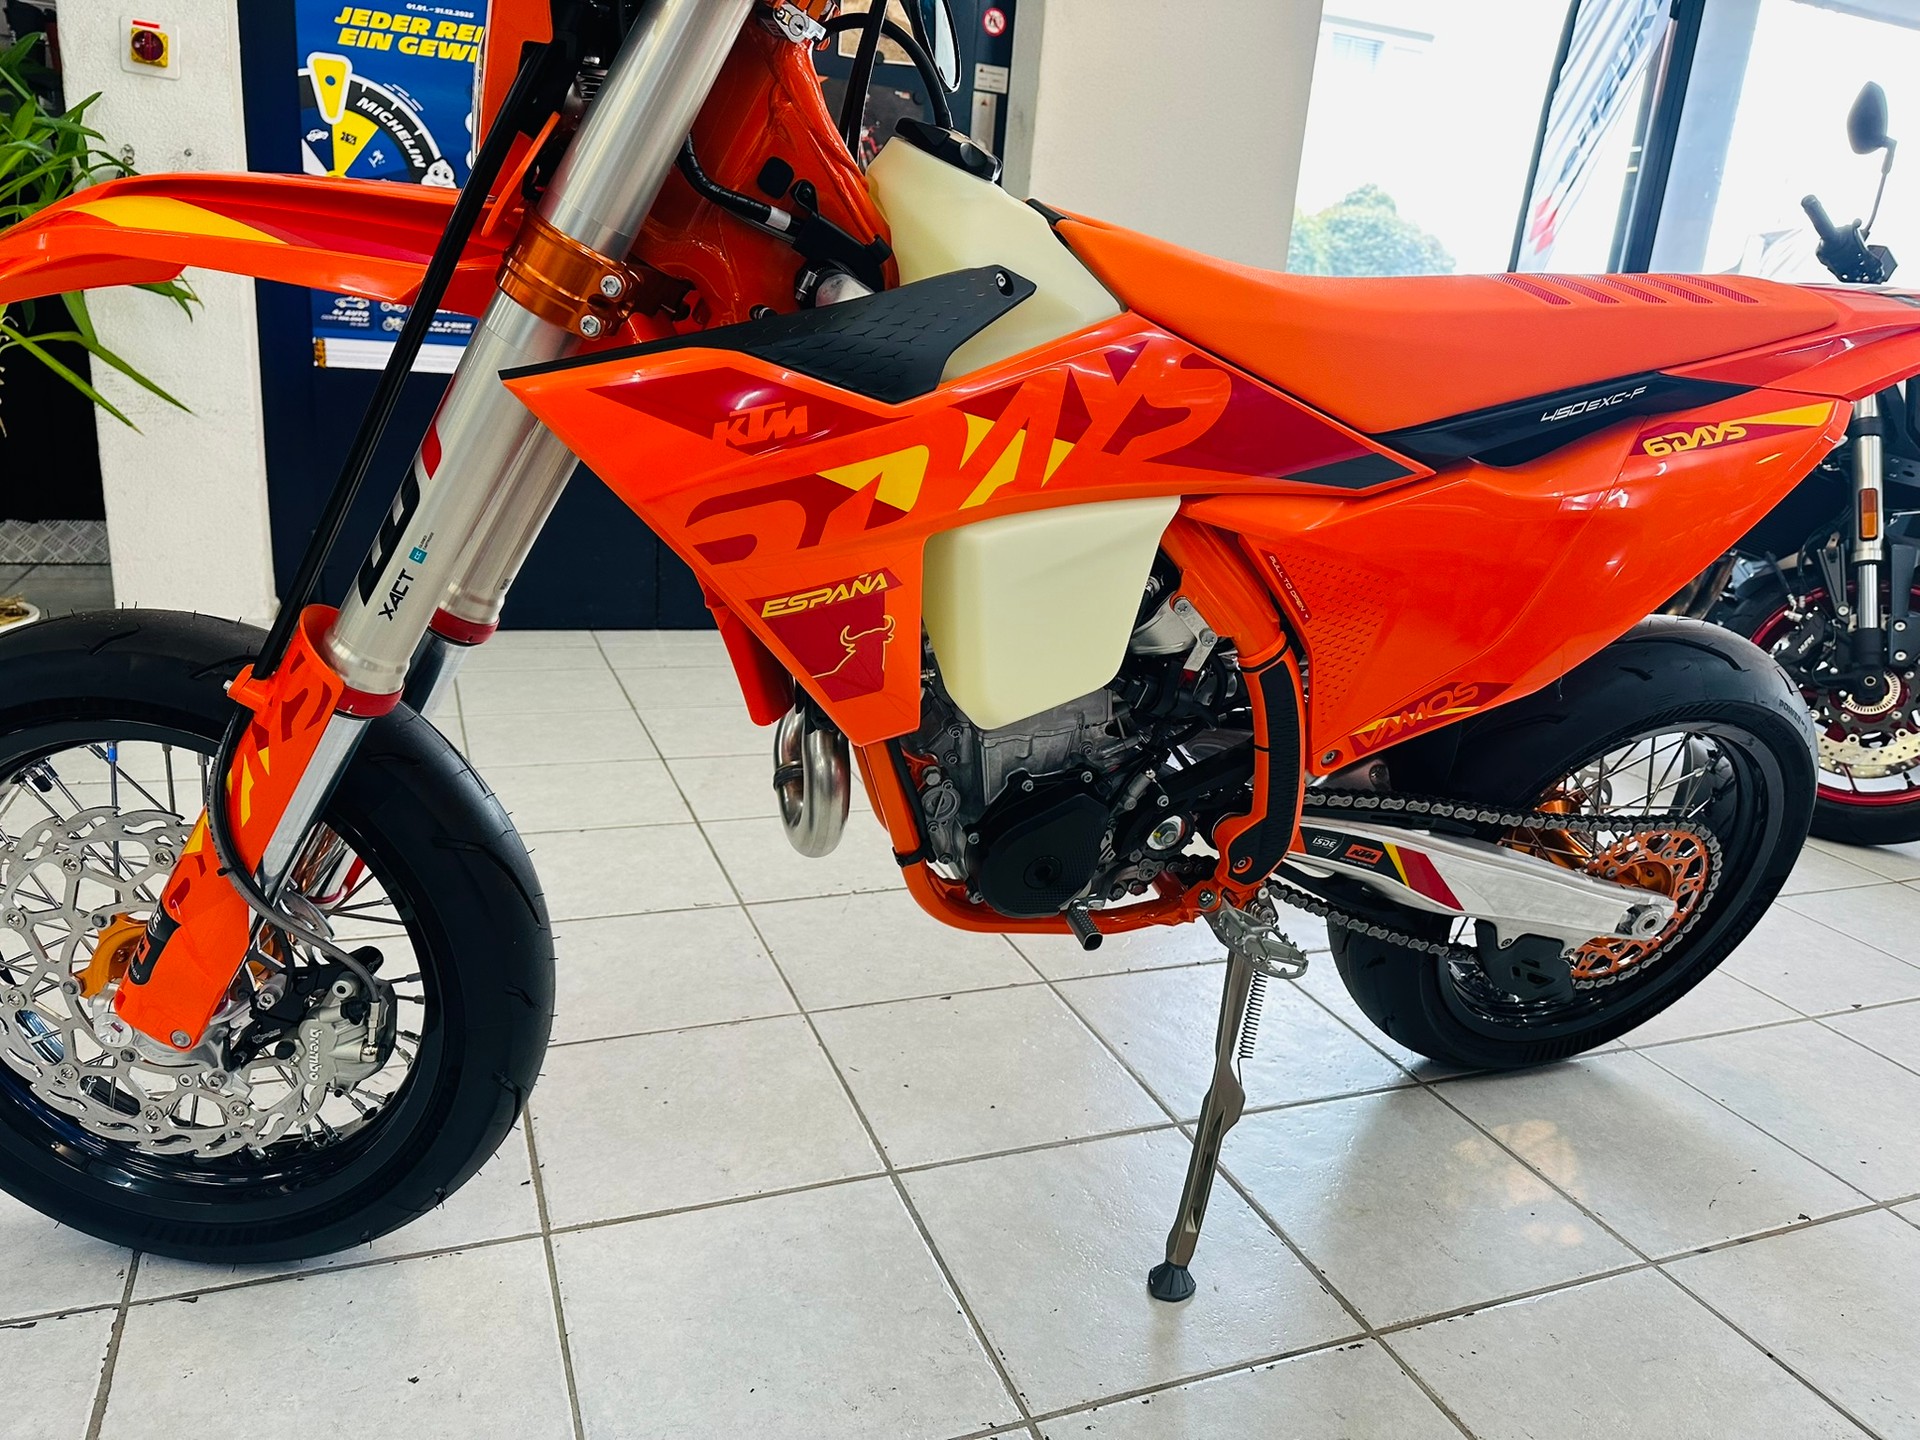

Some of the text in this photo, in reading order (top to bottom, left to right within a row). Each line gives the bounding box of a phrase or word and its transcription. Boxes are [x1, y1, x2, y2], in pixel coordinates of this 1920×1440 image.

[334, 6, 431, 36] JEDER
[337, 28, 394, 51] EIN
[356, 96, 427, 169] MICHELIN
[712, 401, 809, 448] KTM
[1642, 421, 1747, 457] 6DAYS
[378, 568, 414, 621] XACT
[761, 572, 888, 618] ESPAÑA
[1269, 555, 1306, 612] PULL TO OPEN
[1355, 682, 1479, 748] VAMOS
[1312, 837, 1337, 848] ISDE
[1350, 848, 1377, 861] KTM
[309, 1028, 323, 1081] brembo
